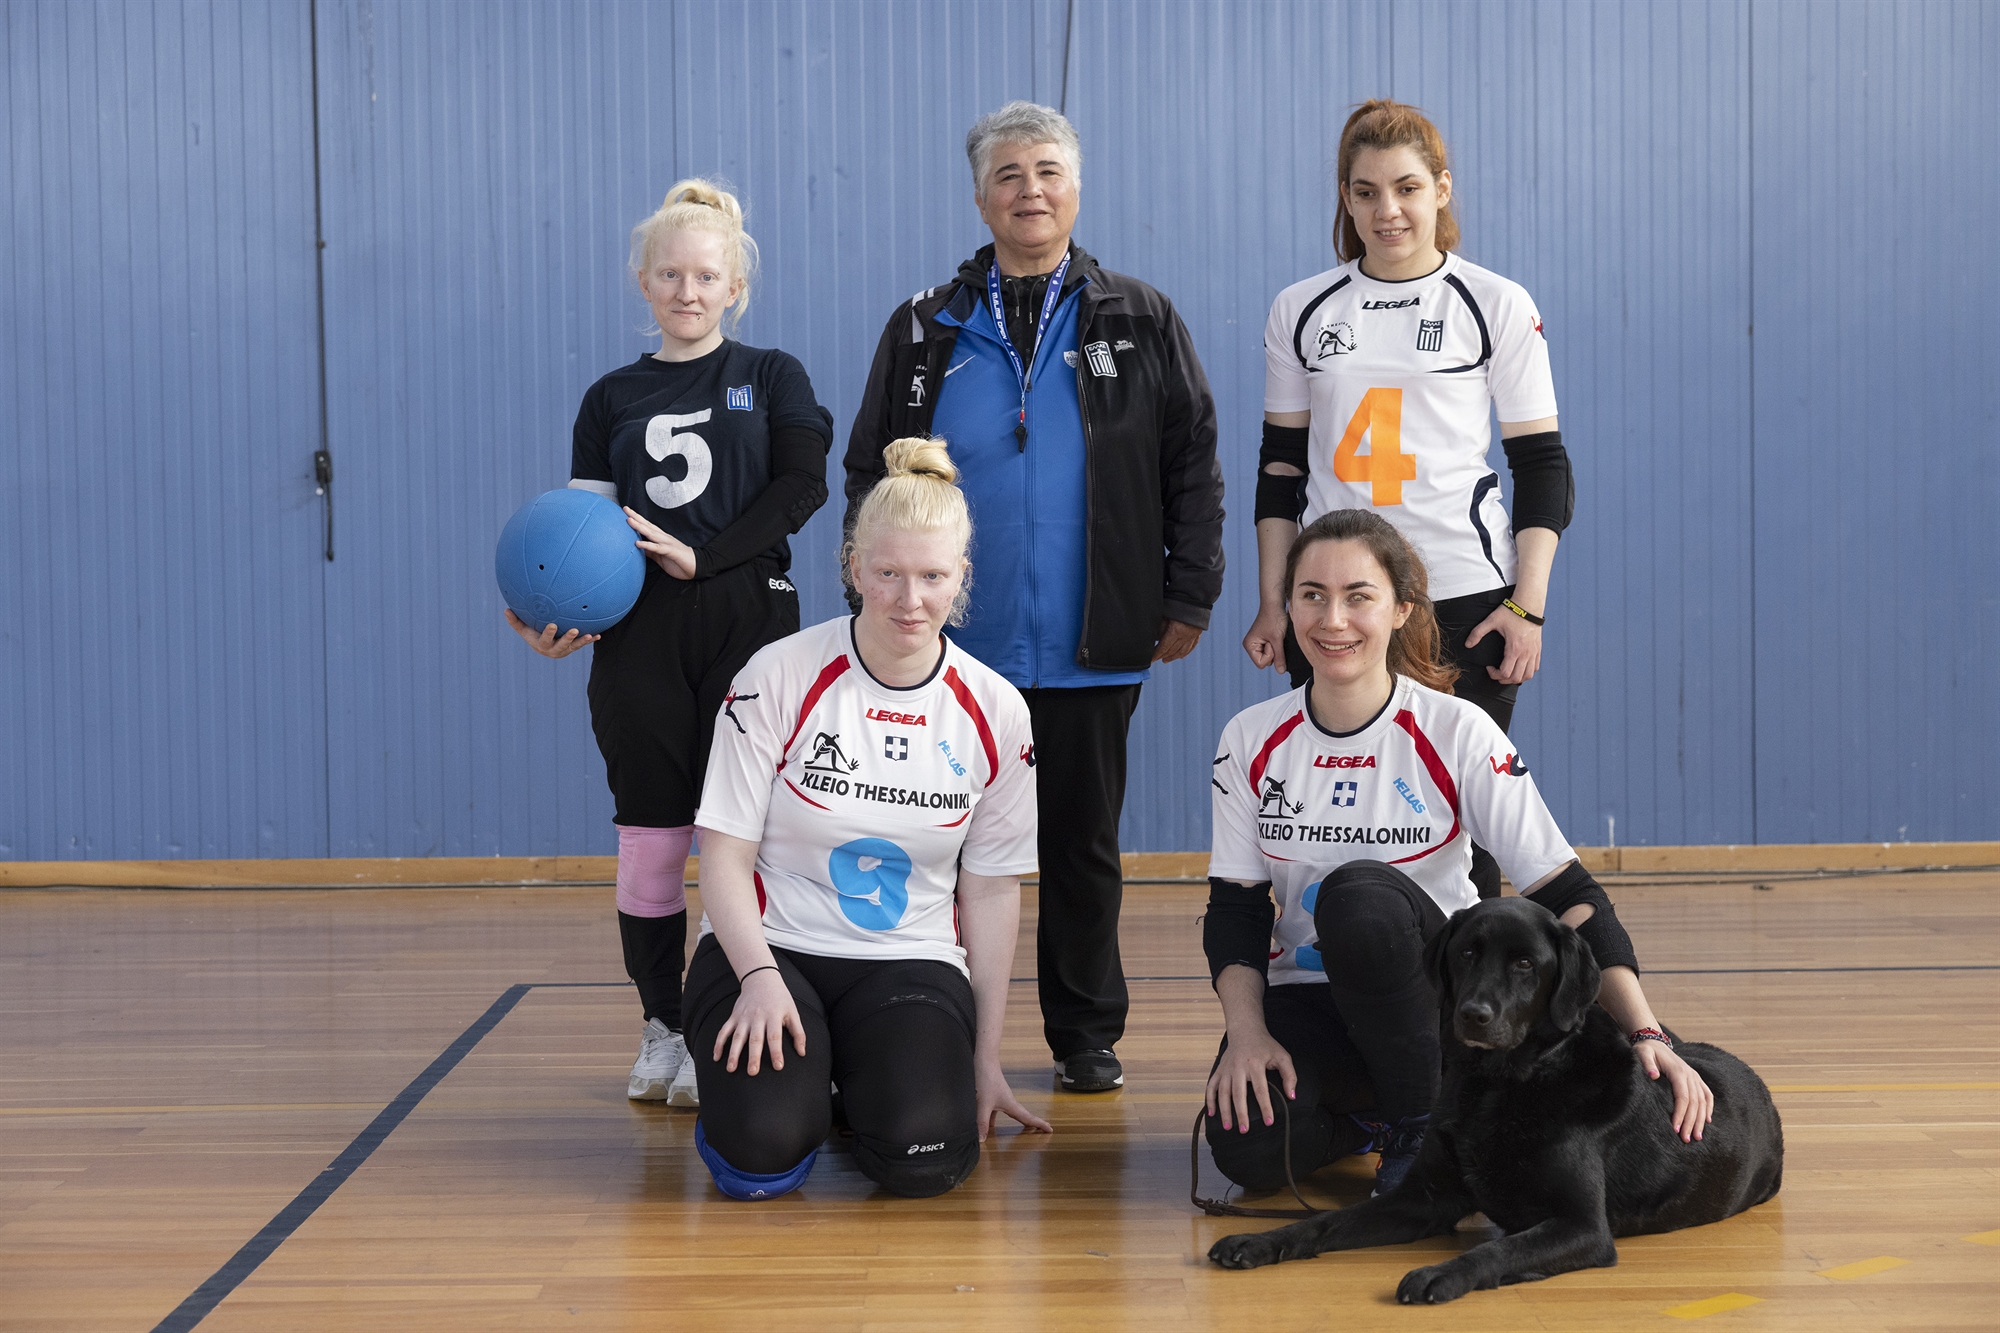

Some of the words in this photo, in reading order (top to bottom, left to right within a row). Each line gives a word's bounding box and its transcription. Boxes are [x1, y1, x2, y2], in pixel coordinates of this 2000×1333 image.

[1361, 296, 1421, 310] LEGEA
[645, 407, 713, 510] 5
[1333, 387, 1417, 507] 4
[1502, 598, 1528, 618] OPEN
[865, 707, 928, 727] LEGEA
[937, 739, 967, 778] HELLAS
[1313, 755, 1377, 769] LEGEA
[800, 771, 850, 796] KLEIO
[853, 782, 970, 810] THESSALONIKI
[1392, 777, 1427, 815] HELLAS
[1258, 822, 1294, 842] KLEIO
[1298, 824, 1431, 845] THESSALONIKI
[828, 836, 912, 931] 9
[920, 1142, 945, 1153] asics
